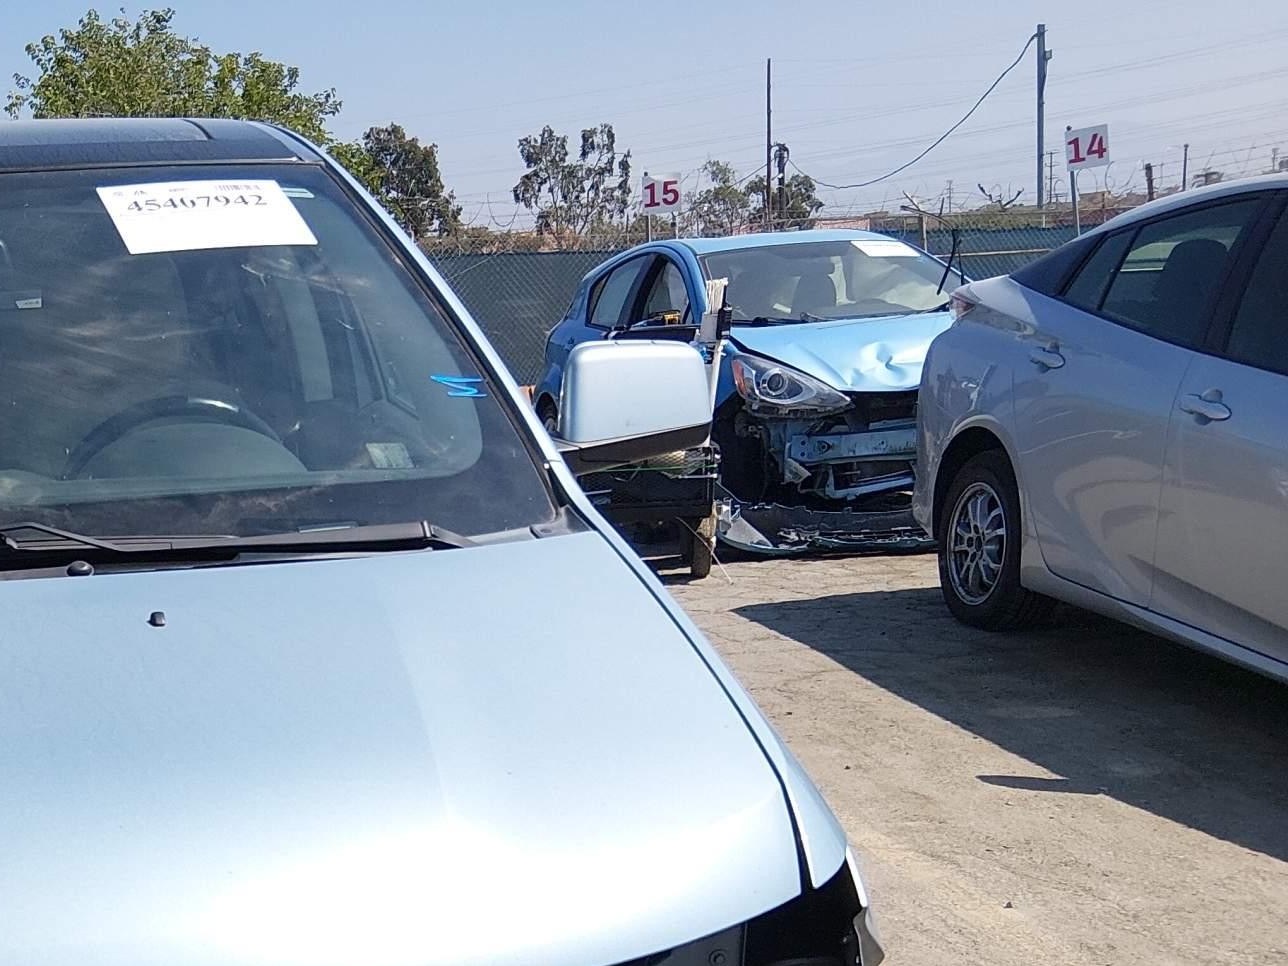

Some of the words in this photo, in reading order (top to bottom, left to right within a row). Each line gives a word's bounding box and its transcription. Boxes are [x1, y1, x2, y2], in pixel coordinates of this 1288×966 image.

[1067, 133, 1107, 164] 14
[127, 194, 268, 212] 45407942
[644, 180, 679, 208] 15
